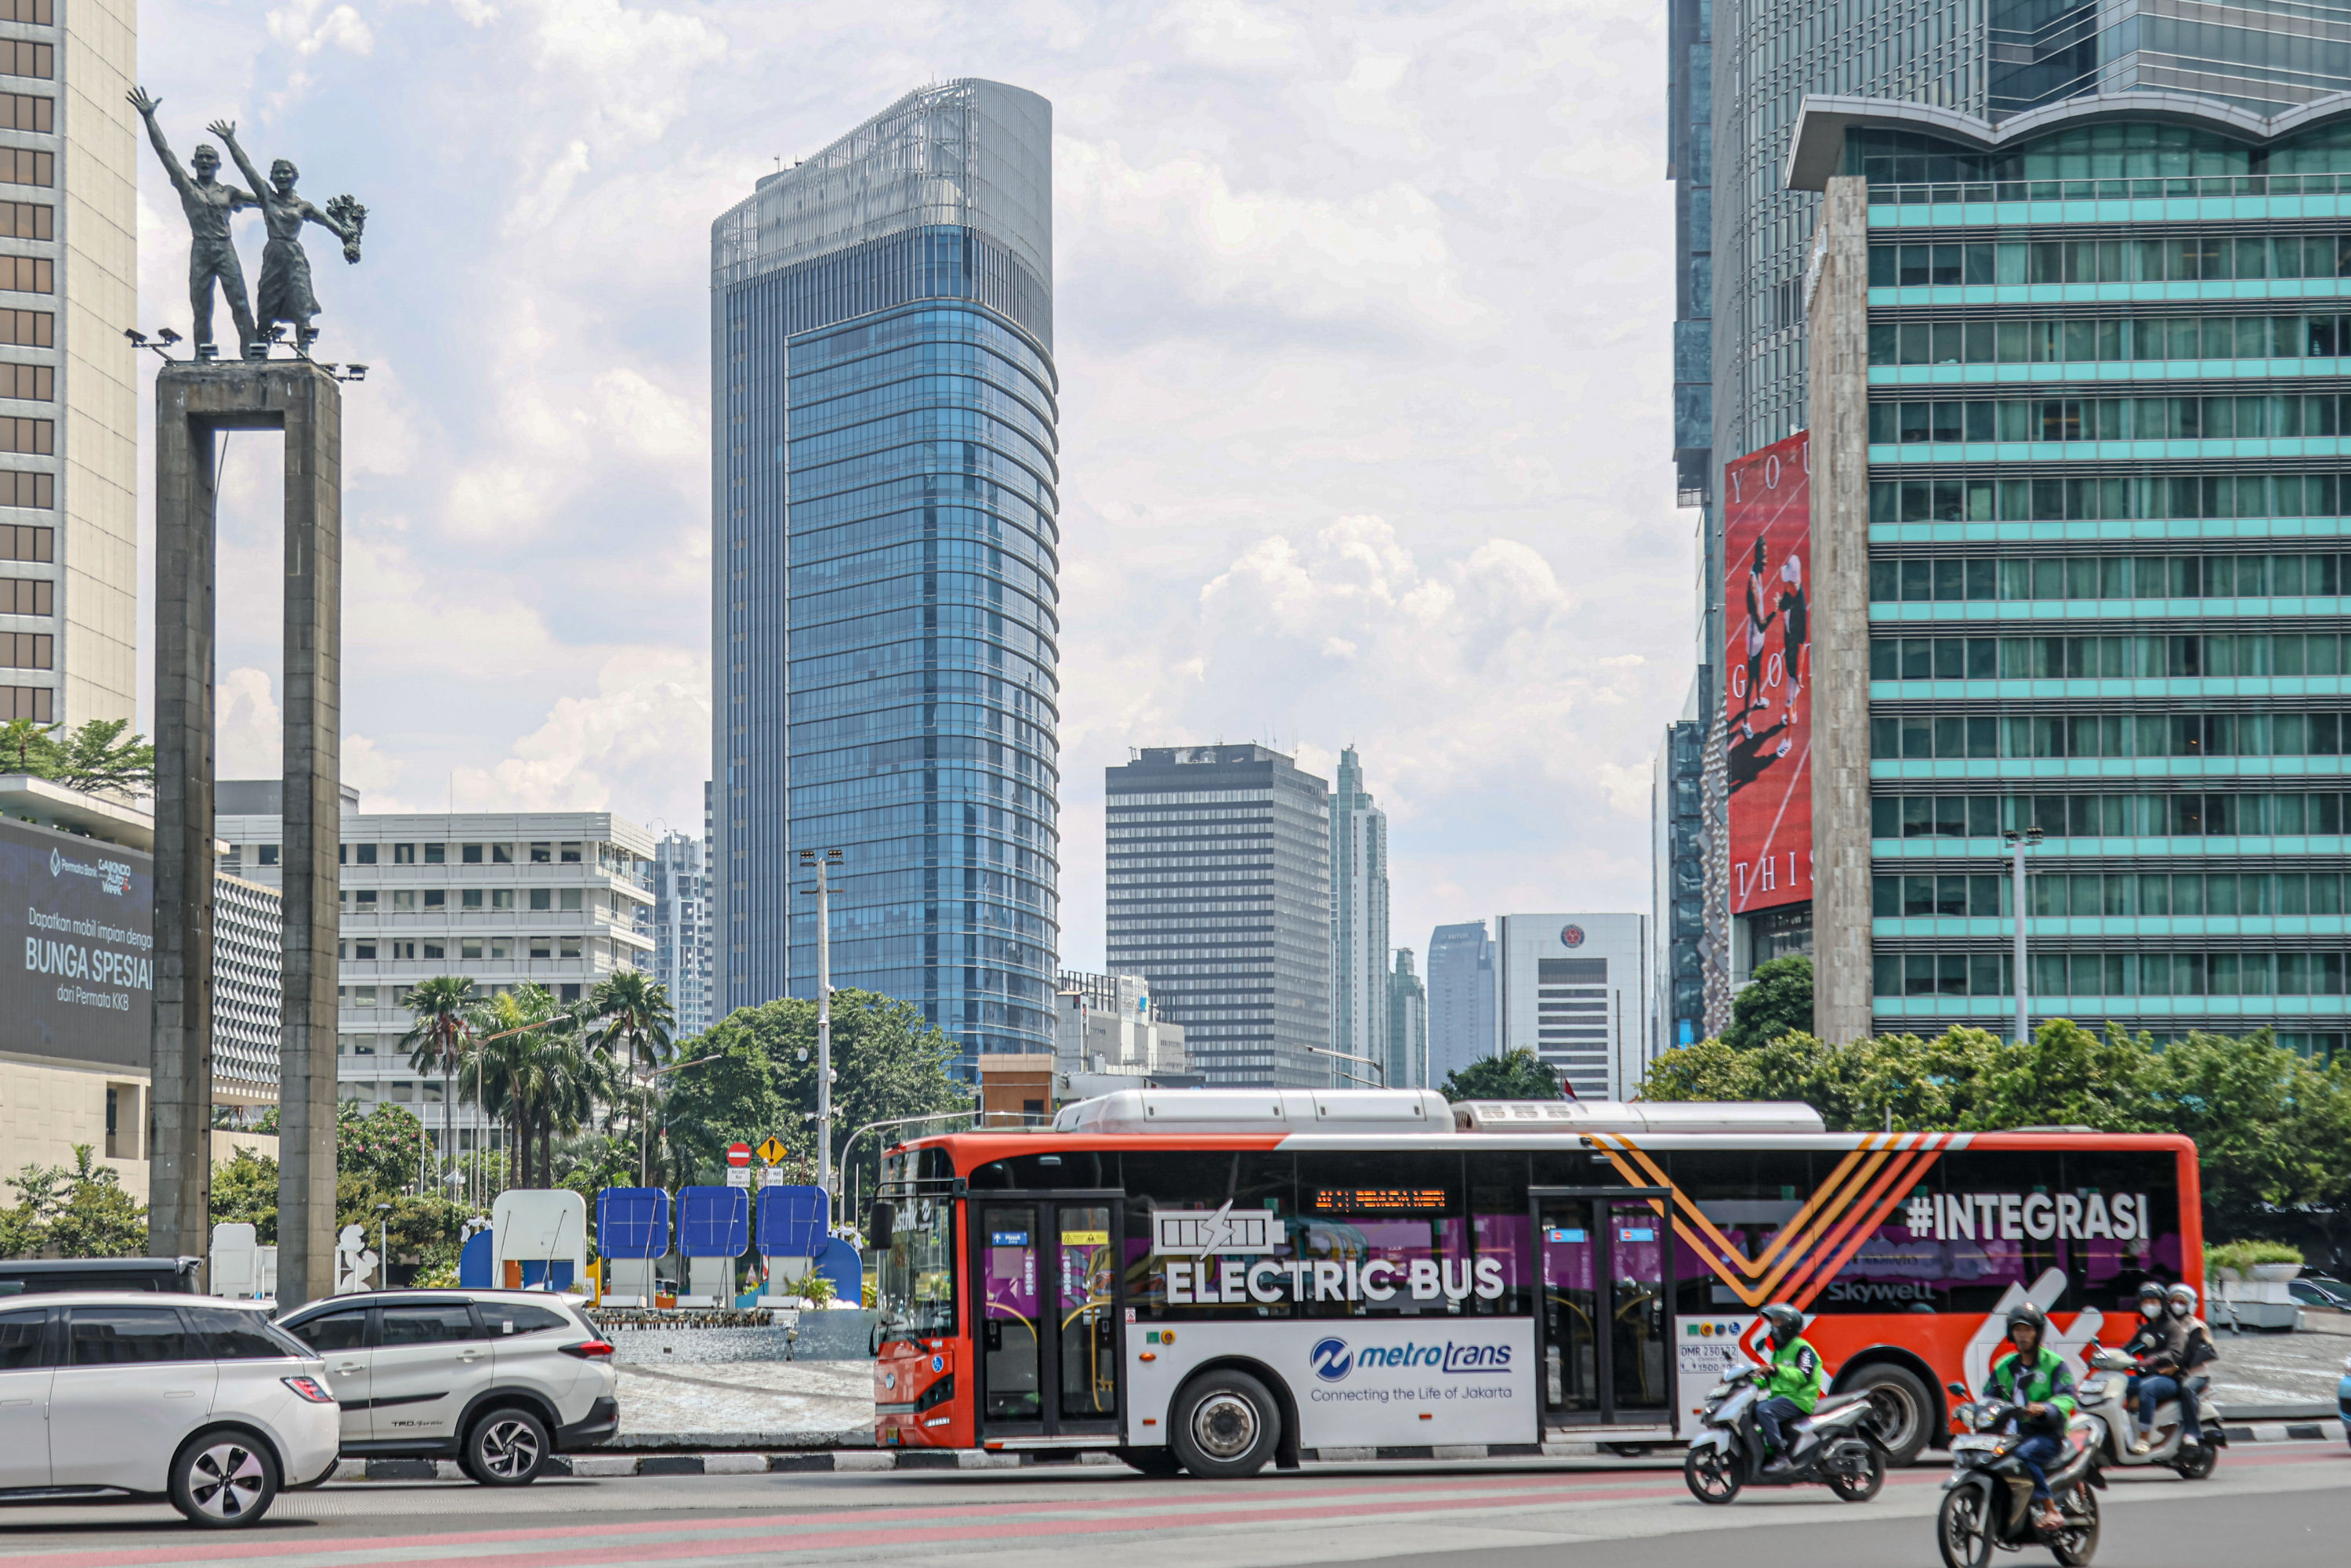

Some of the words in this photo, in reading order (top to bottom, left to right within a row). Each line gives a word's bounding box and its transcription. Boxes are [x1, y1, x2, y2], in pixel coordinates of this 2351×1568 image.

[1734, 850, 1813, 897] THI
[29, 907, 71, 932] Dapatkan
[73, 918, 96, 937] mobil
[97, 921, 125, 944] impian
[26, 936, 89, 980] BUNGA
[57, 983, 74, 1002] dari
[76, 987, 110, 1009] Permata
[112, 992, 129, 1011] KKB
[1906, 1193, 2150, 1240] #INTEGRASI
[1166, 1260, 1397, 1304] ELECTRIC
[1411, 1258, 1505, 1301] BUS
[1828, 1280, 1936, 1303] Skywell
[1357, 1341, 1512, 1374] metrotrans
[1681, 1346, 1701, 1356] DMR
[1311, 1388, 1389, 1403] Connecting
[1393, 1388, 1415, 1400] the
[1418, 1387, 1441, 1400] Life
[1445, 1387, 1458, 1400] of
[1462, 1386, 1512, 1400] Jakarta
